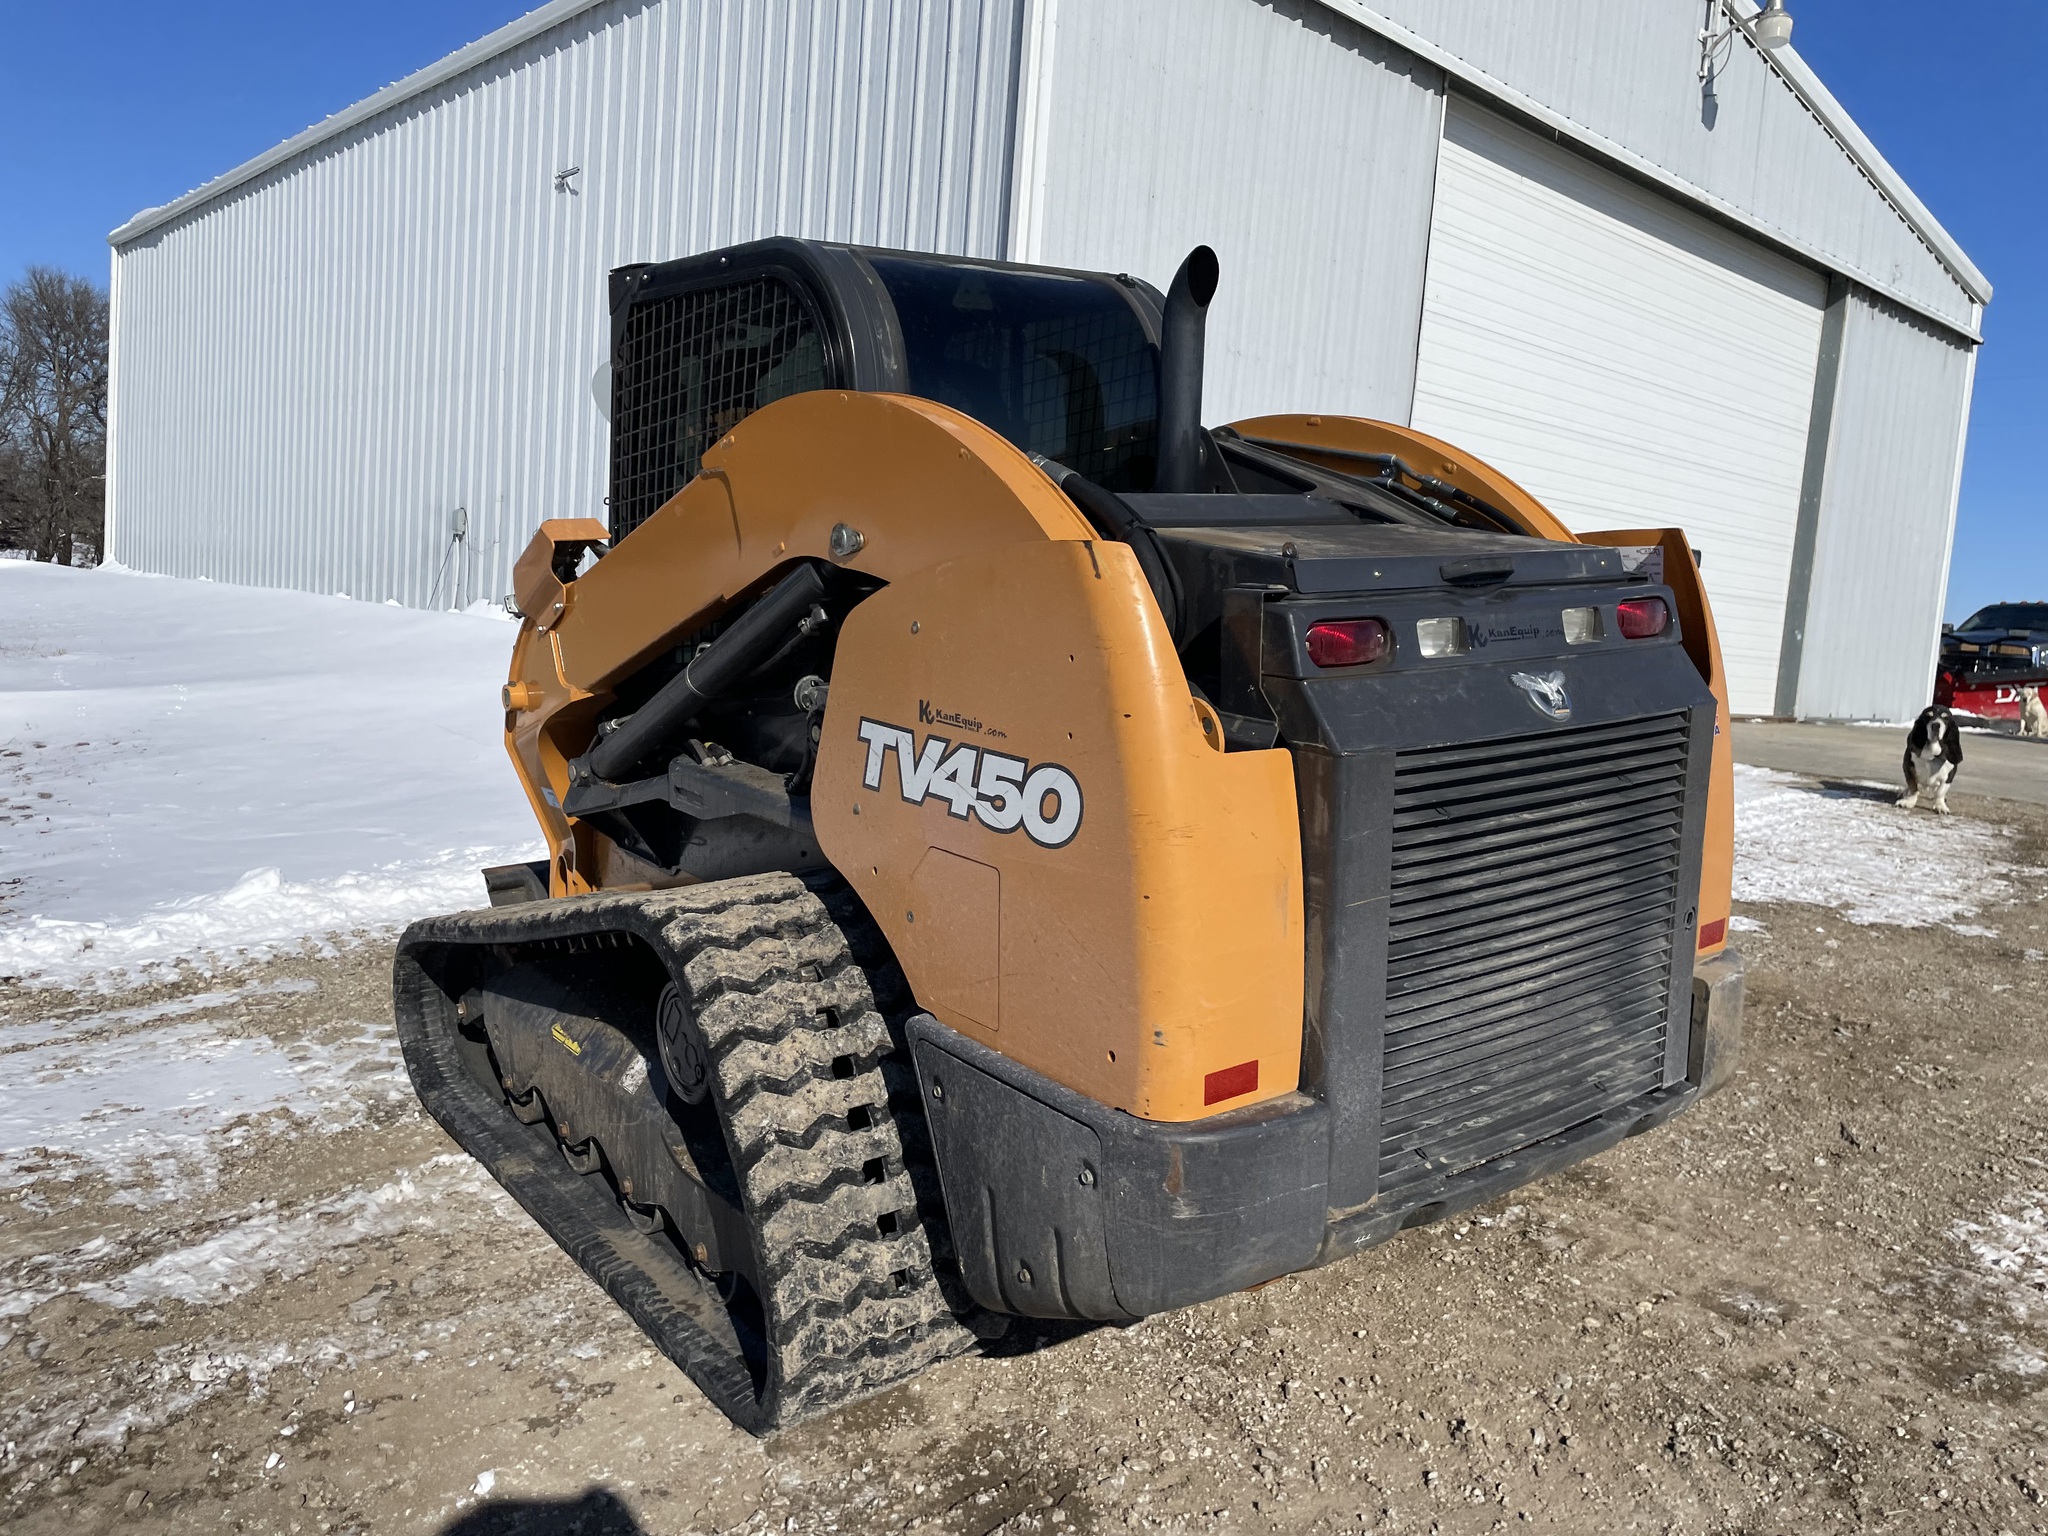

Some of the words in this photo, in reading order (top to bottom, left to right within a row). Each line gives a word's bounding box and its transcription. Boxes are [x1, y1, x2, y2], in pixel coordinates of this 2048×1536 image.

[1488, 625, 1540, 640] KanEquip
[935, 708, 983, 732] KanEquip
[983, 727, 1007, 739] .com
[857, 715, 1085, 850] TV450
